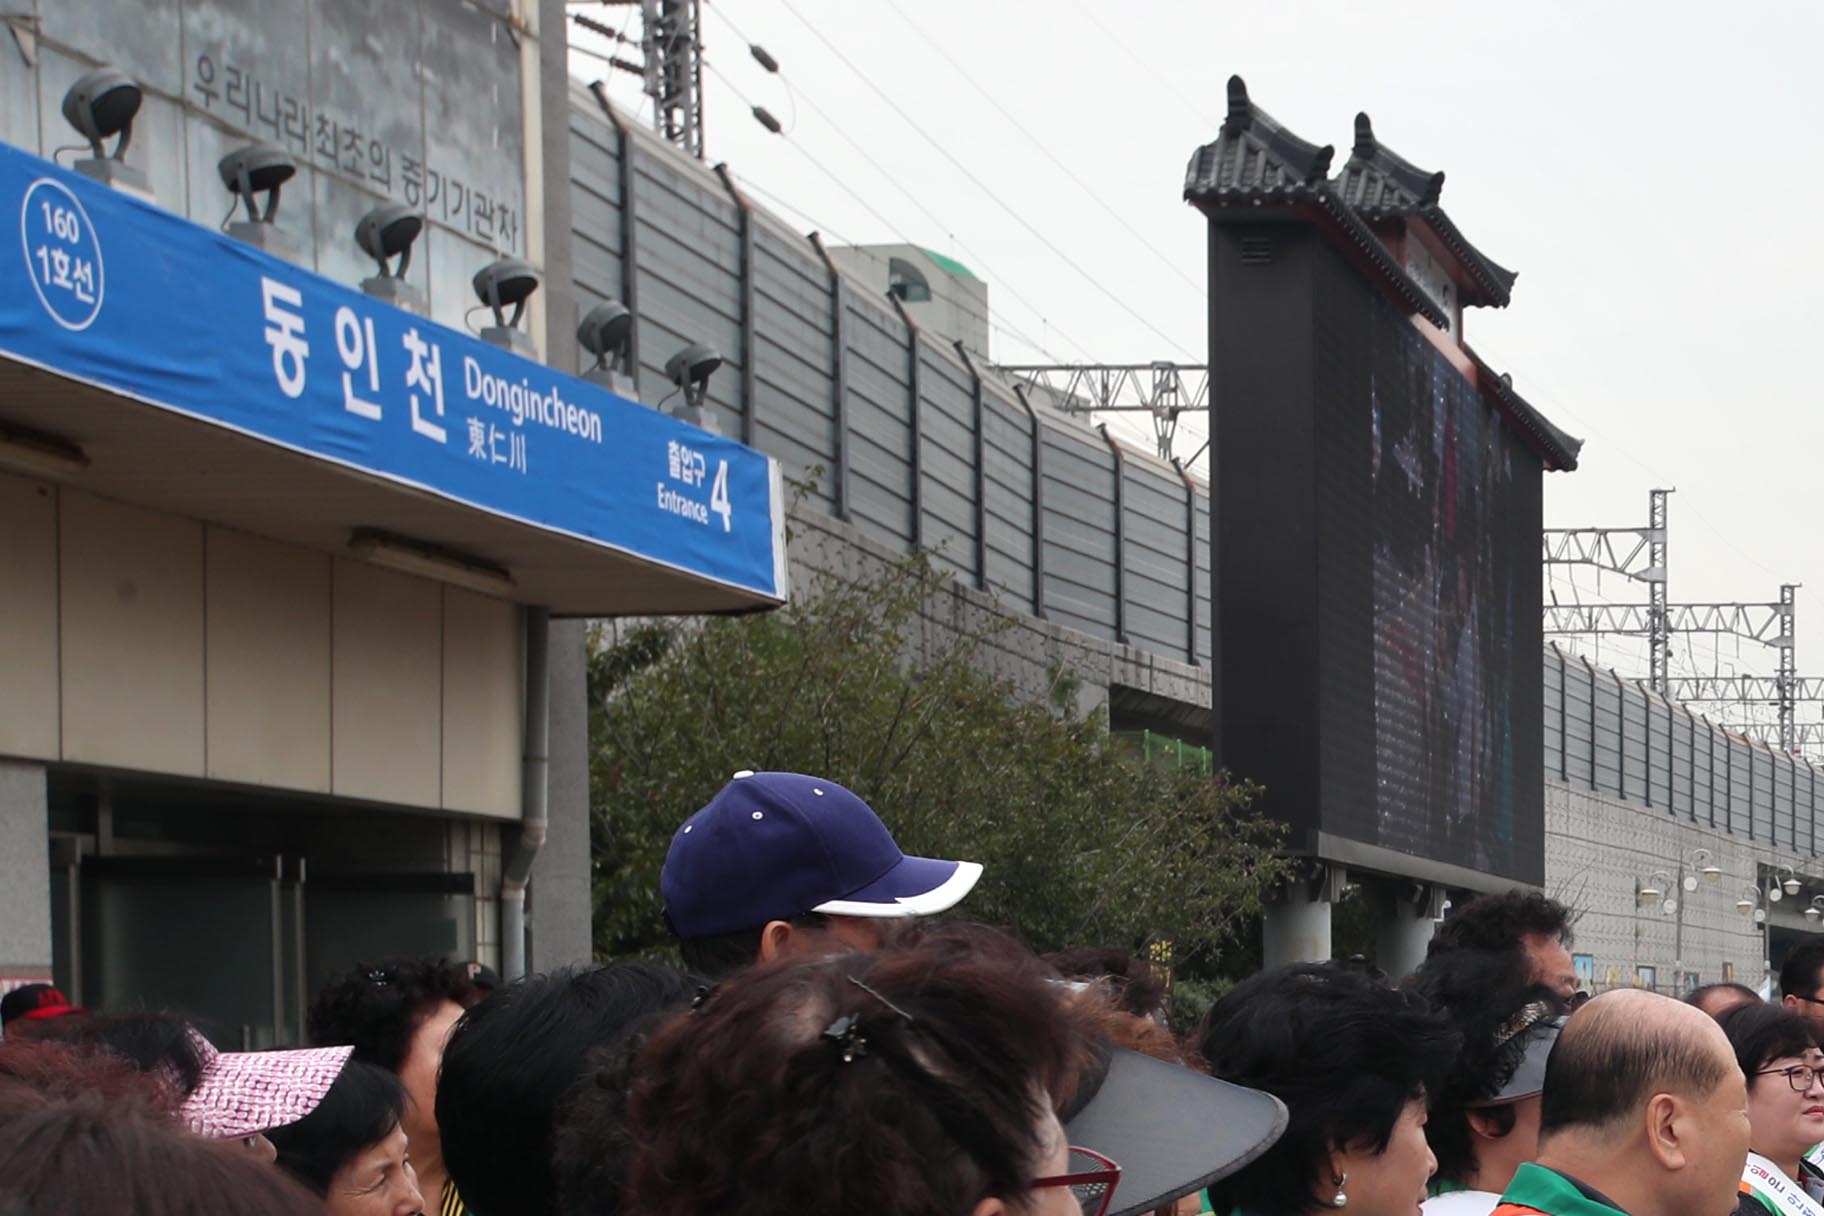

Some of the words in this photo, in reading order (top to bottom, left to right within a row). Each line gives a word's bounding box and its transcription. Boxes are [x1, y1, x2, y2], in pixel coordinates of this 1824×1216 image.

[42, 201, 79, 244] 160
[36, 244, 95, 304] 1호선
[260, 275, 447, 444] 동인천
[464, 356, 602, 443] Dongincheon
[467, 416, 527, 475] 東仁川
[667, 439, 706, 488] 출입구
[656, 482, 709, 526] Entrance
[711, 459, 732, 533] 4
[1746, 1163, 1786, 1194] 일은
